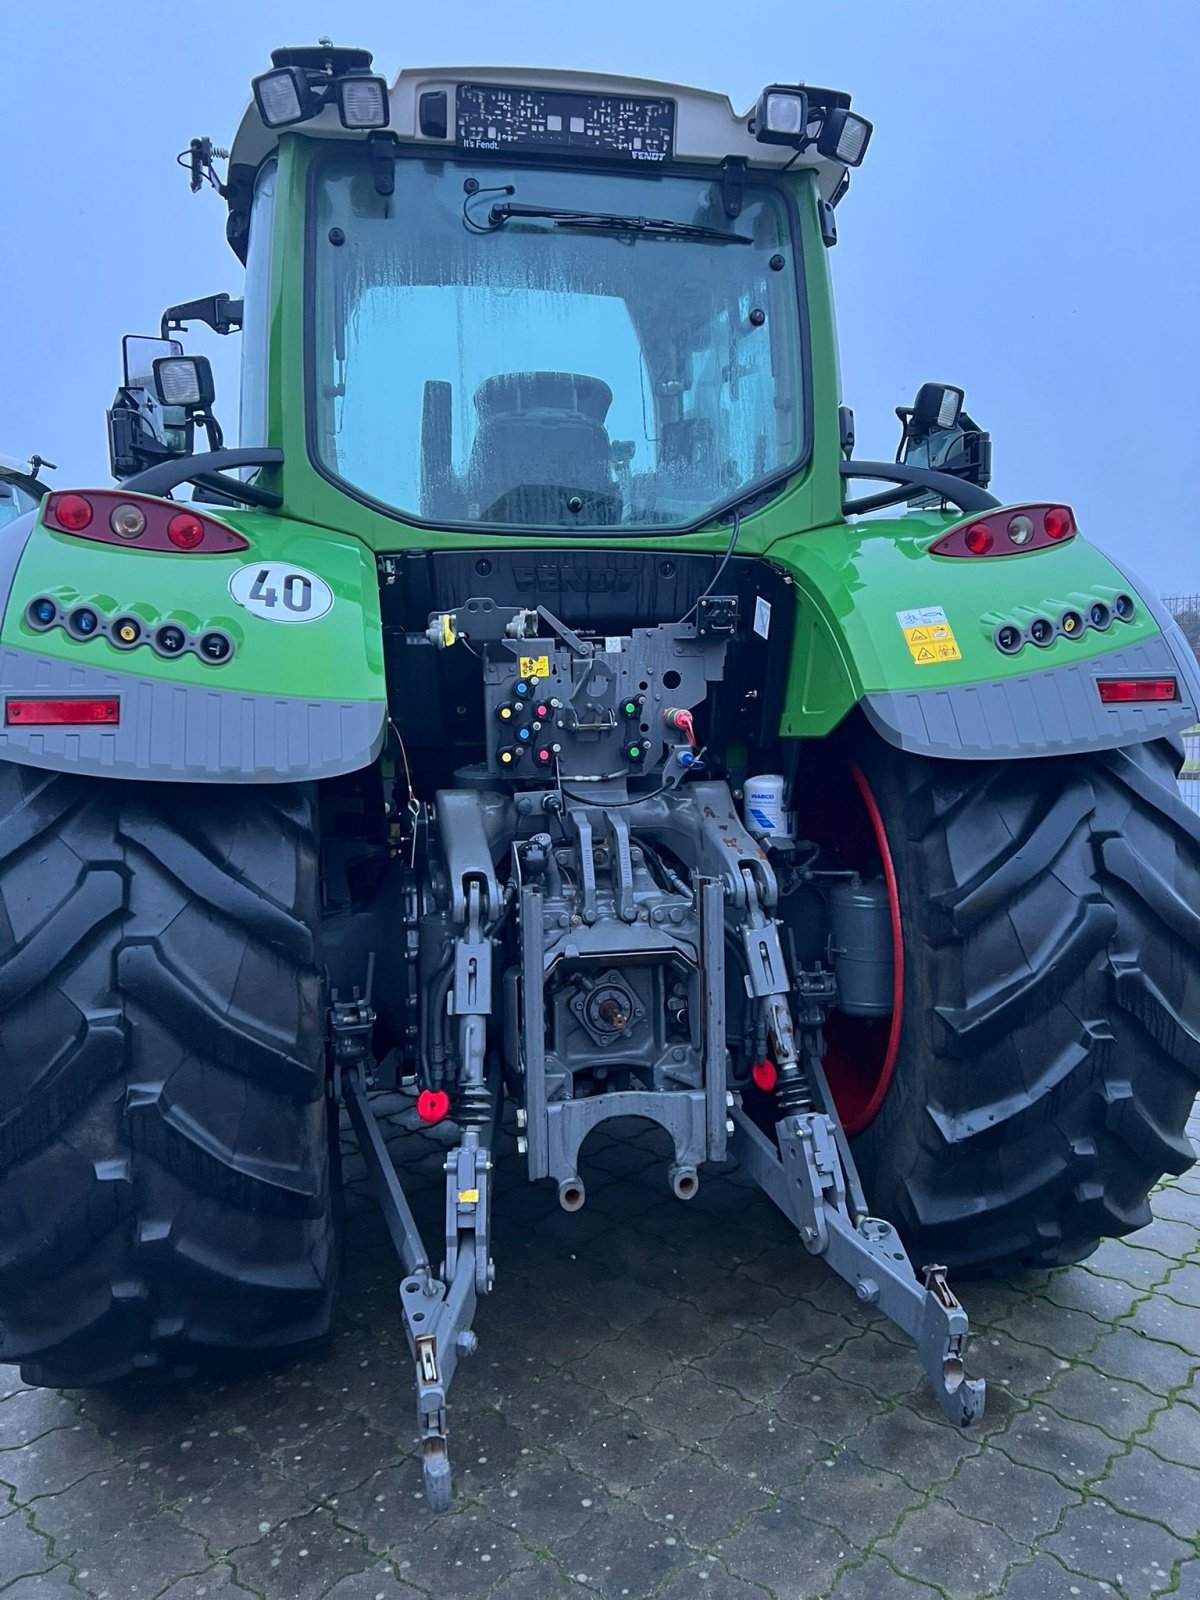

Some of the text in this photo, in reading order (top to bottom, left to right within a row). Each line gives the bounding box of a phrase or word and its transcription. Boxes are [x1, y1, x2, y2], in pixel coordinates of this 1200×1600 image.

[463, 138, 475, 148] It's
[631, 150, 666, 161] FENDT
[511, 567, 641, 593] FENDT
[248, 569, 312, 613] 40
